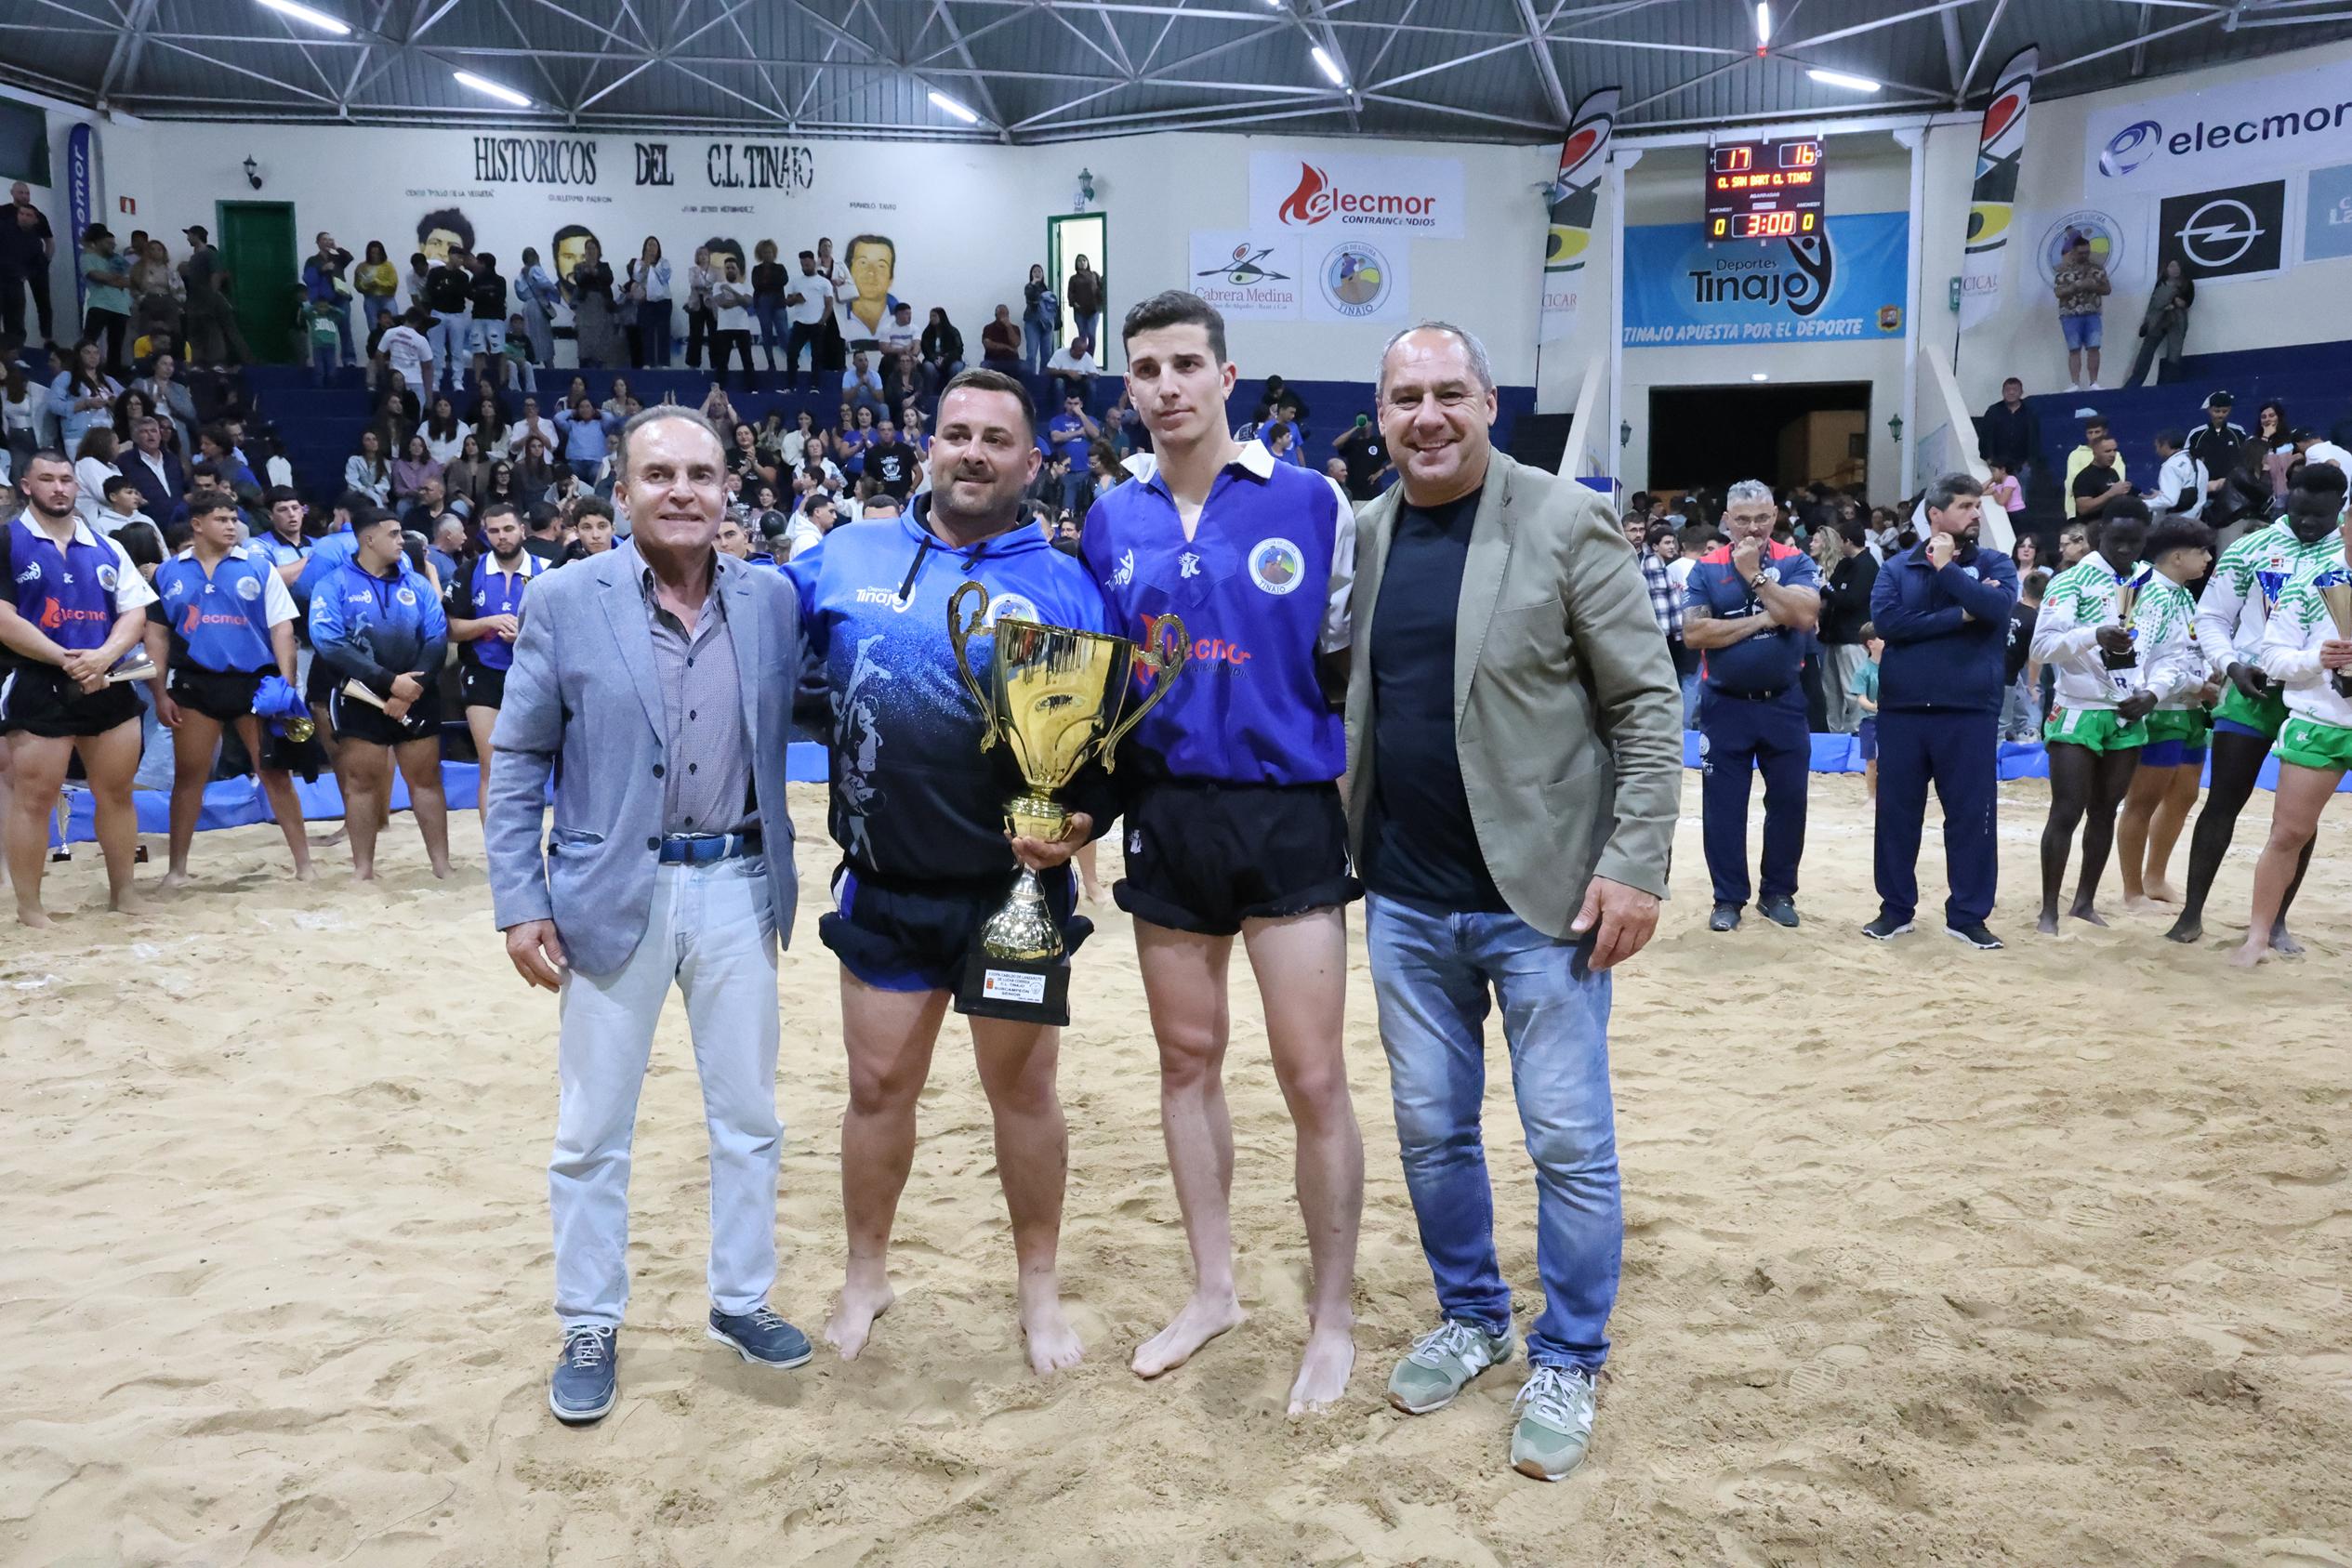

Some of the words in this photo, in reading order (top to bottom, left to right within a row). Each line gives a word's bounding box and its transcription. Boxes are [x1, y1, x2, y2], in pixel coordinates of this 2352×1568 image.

[2169, 101, 2352, 156] elecmor
[474, 138, 597, 185] HISTORICOS
[635, 142, 674, 186] DEL
[1730, 149, 1750, 169] 17
[1795, 145, 1815, 165] 16
[1717, 177, 1729, 189] CL
[1731, 175, 1748, 188] SAN
[1750, 174, 1771, 187] BART
[1772, 173, 1784, 185] CL
[1747, 214, 1794, 235] 3:00
[1716, 258, 1777, 272] Deportes
[1195, 286, 1244, 302] Cabrera
[1247, 288, 1294, 303] Medina
[1687, 270, 1808, 306] Tinajo
[1624, 326, 1673, 343] TINAJO
[1676, 324, 1738, 340] APUESTA
[1742, 323, 1774, 339] POR
[1776, 321, 1794, 337] EL
[1797, 318, 1864, 336] DEPORTE
